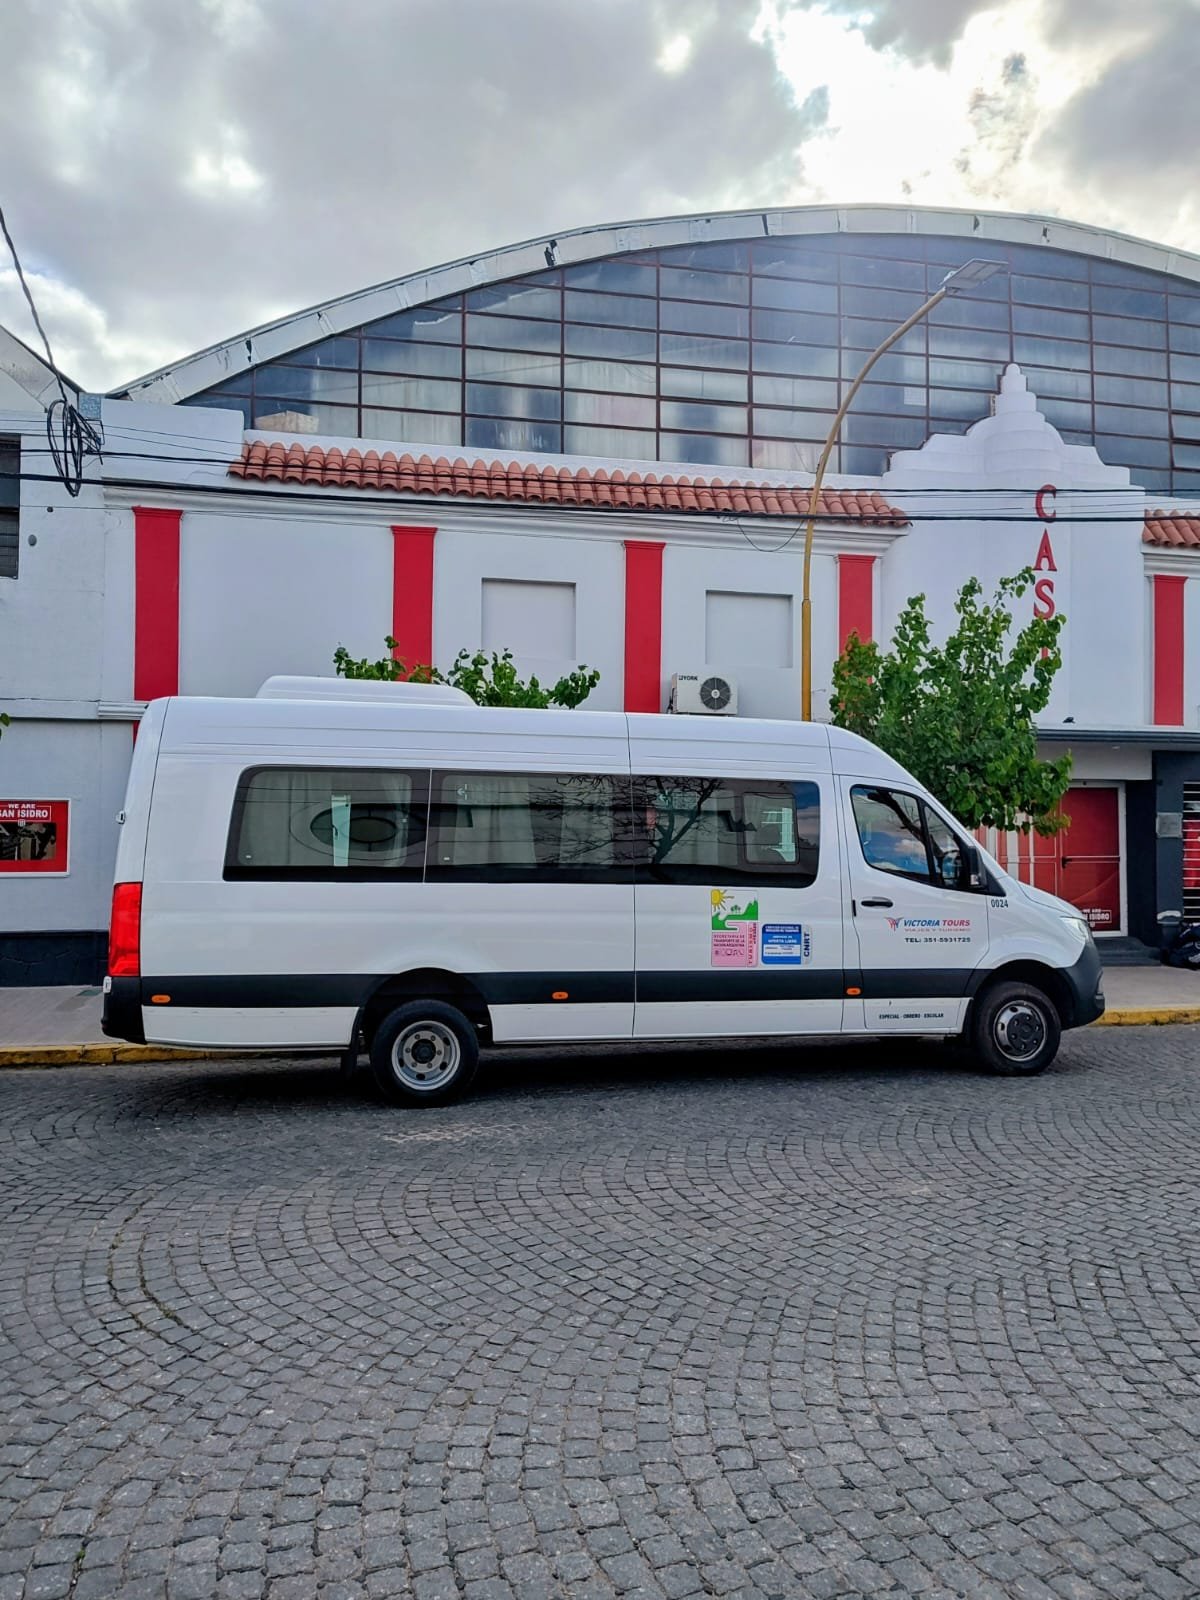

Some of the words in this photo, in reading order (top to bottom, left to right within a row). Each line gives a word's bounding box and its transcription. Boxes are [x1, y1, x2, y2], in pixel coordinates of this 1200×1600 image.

[1032, 484, 1057, 662] CAS
[17, 809, 48, 818] ISIDRO
[991, 899, 1009, 908] 0024
[903, 919, 940, 927] VICTORIA
[942, 919, 970, 927] TOURS
